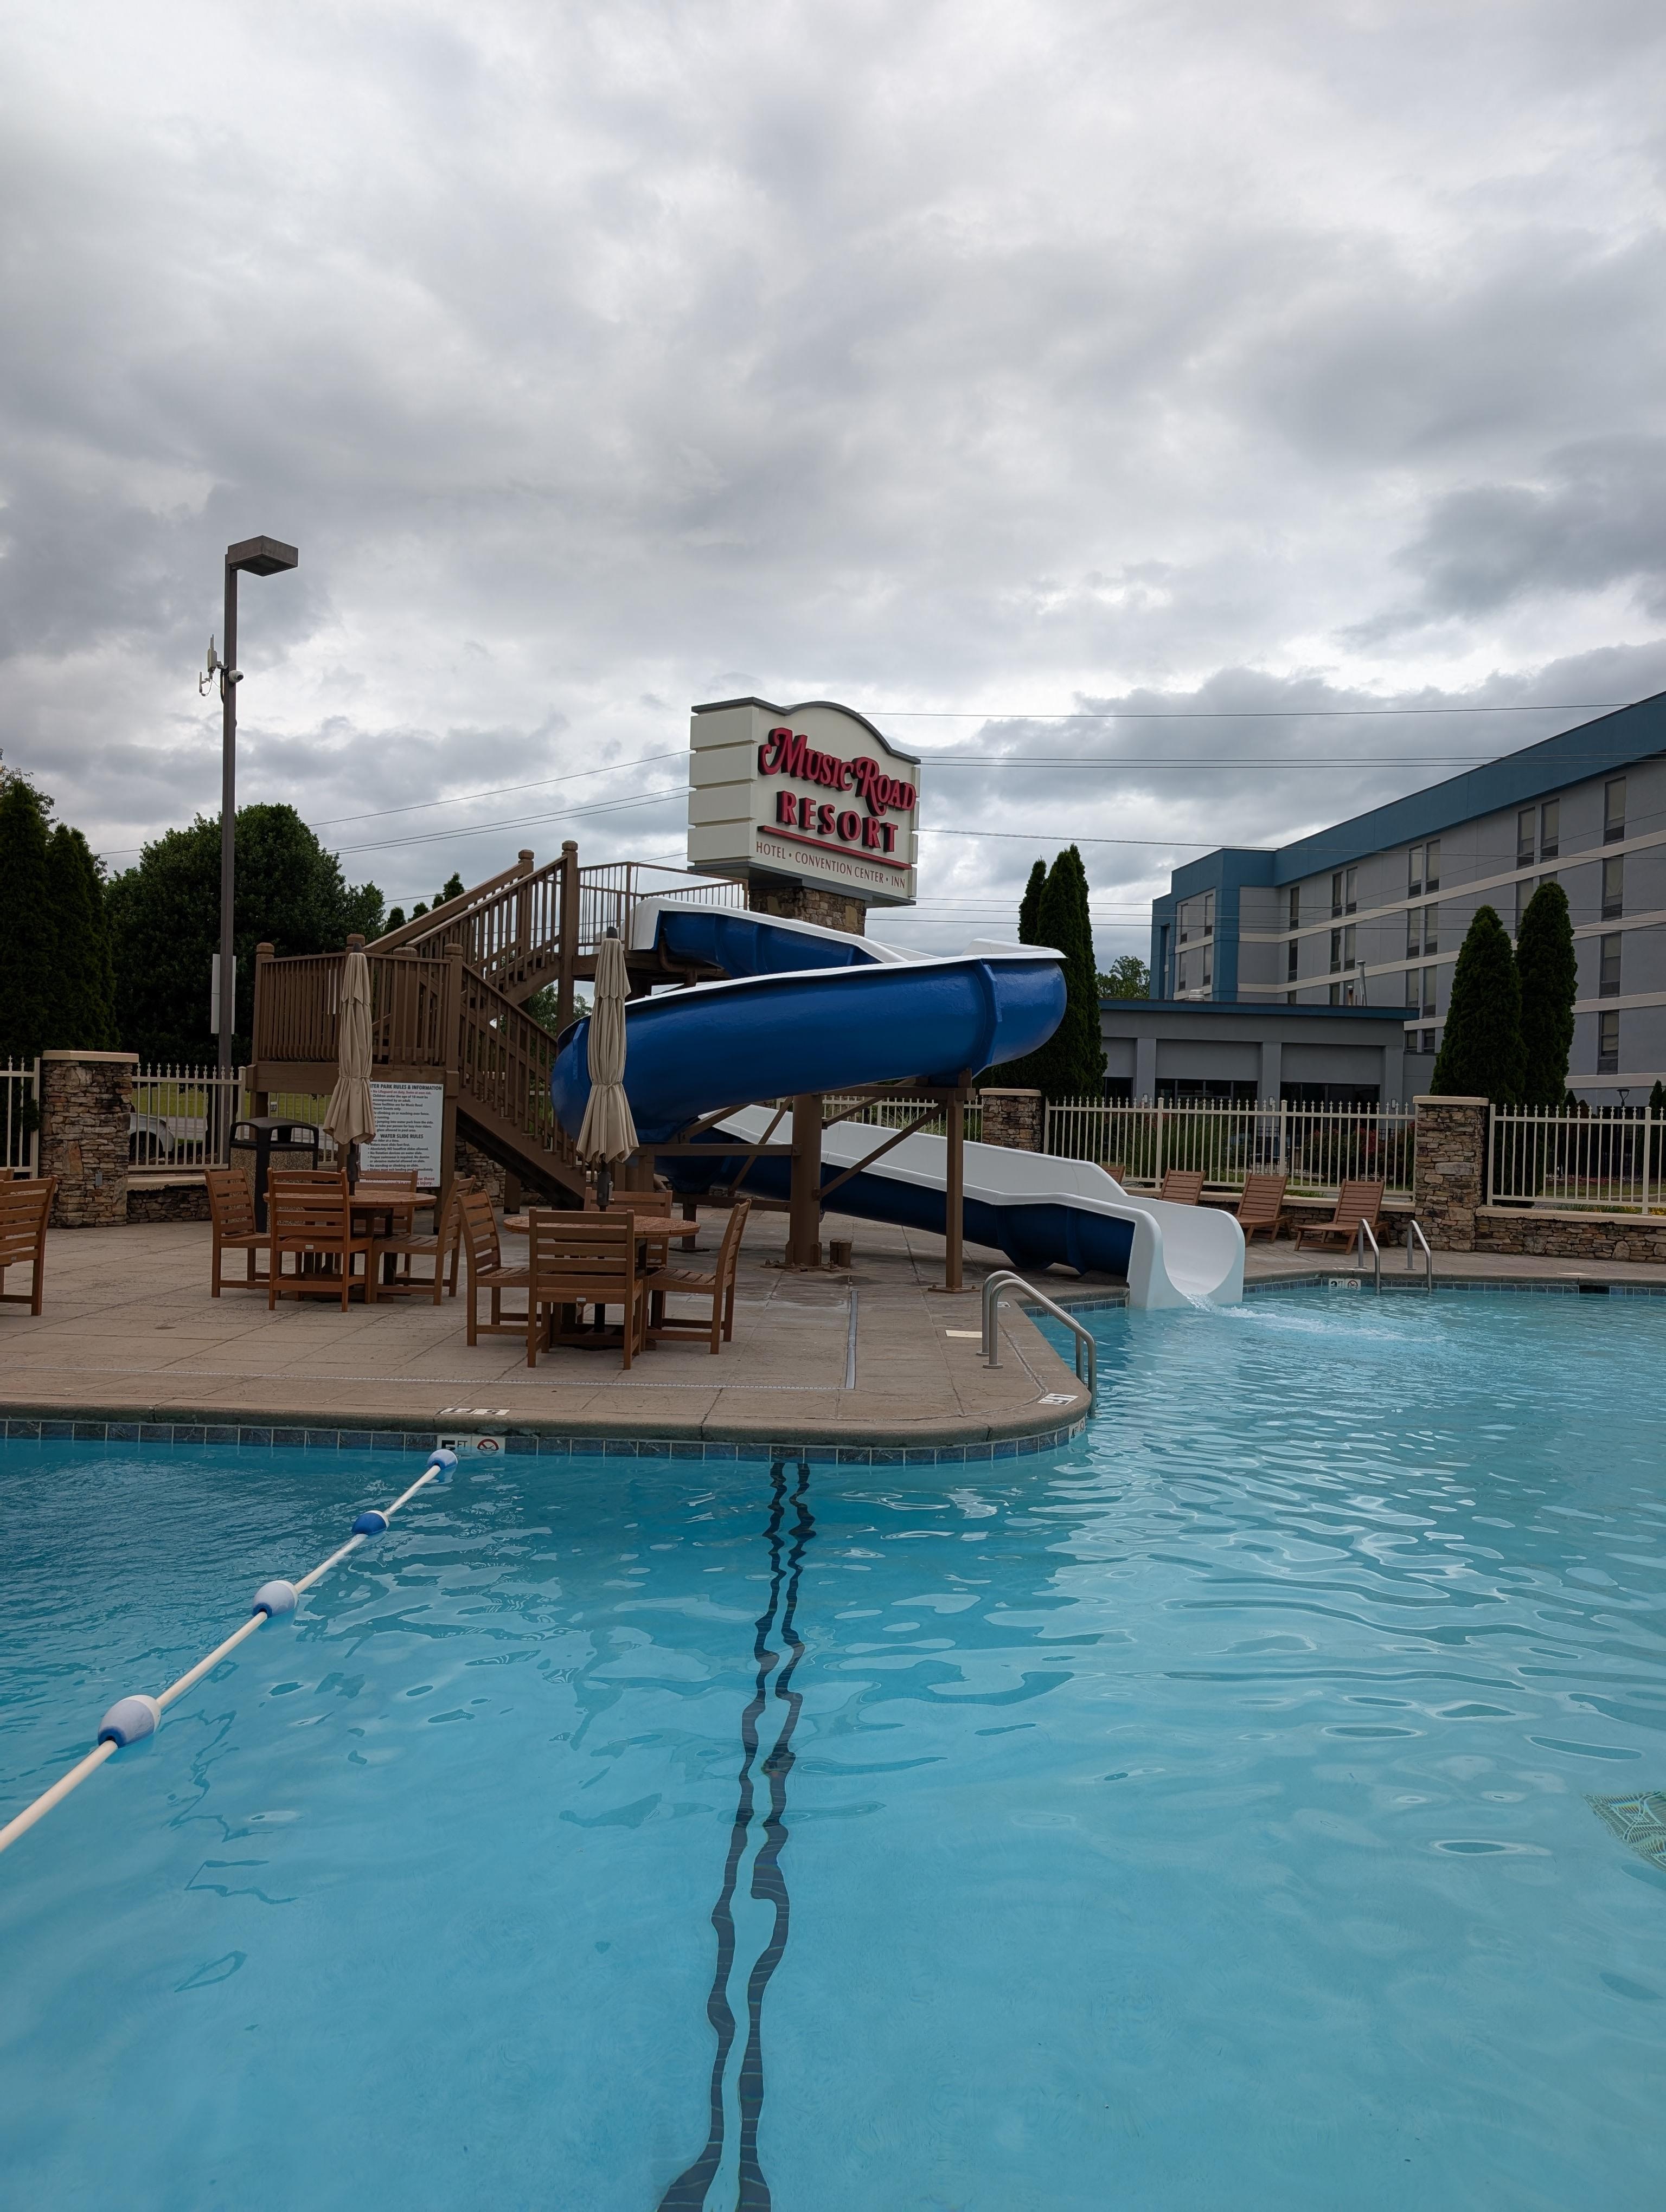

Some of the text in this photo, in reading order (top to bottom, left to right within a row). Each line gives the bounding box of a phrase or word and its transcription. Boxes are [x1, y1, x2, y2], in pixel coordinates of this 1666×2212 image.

[776, 790, 899, 853] RESORT
[756, 841, 906, 889] HOTEL CONVENTION CENTER INN
